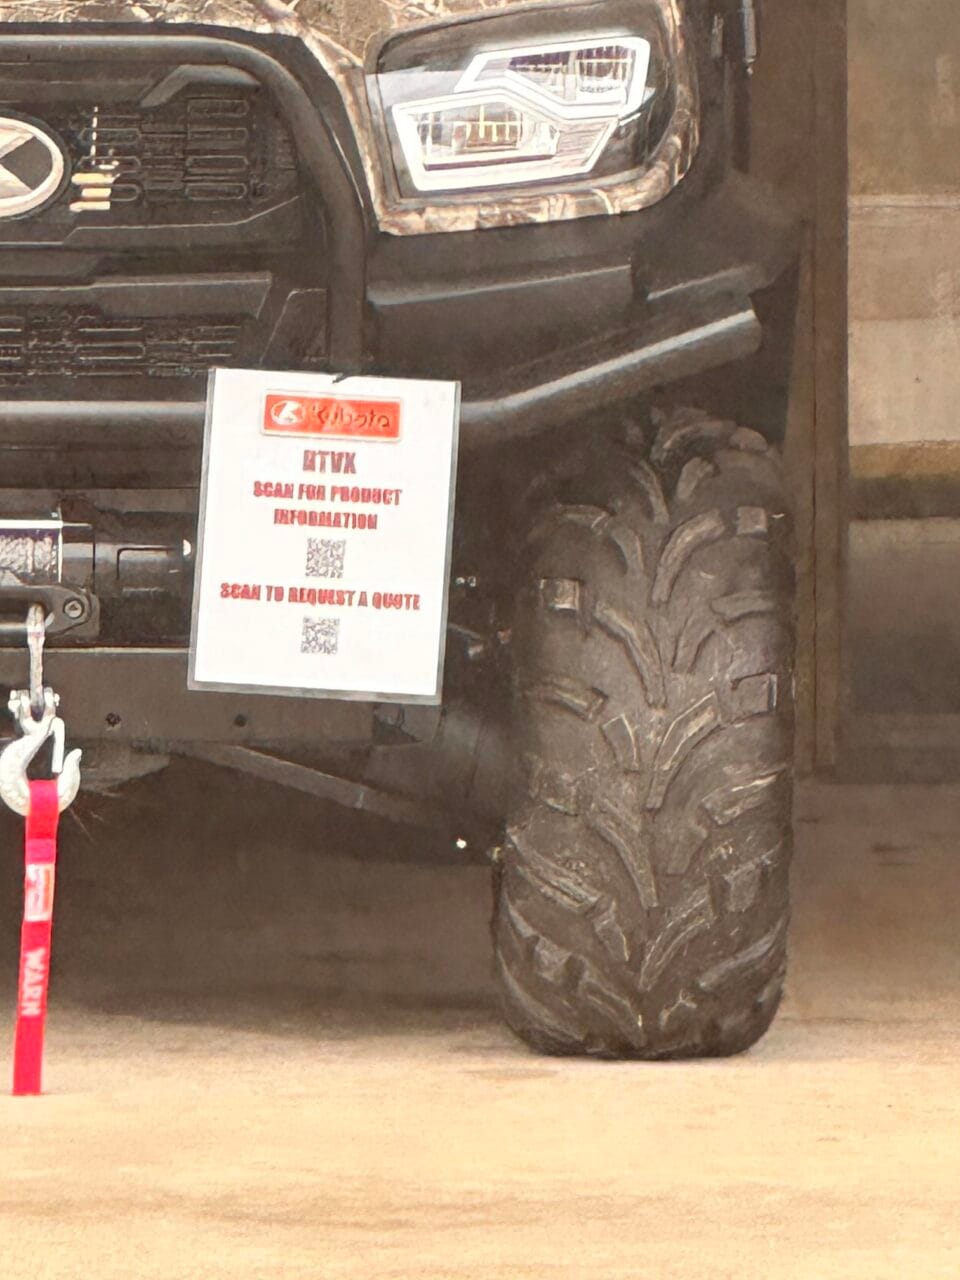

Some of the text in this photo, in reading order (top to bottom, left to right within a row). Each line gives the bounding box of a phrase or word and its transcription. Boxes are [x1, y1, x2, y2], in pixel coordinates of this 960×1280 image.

[303, 449, 356, 474] RTVX
[253, 481, 402, 506] SCAN FOR PRODUCT
[273, 509, 378, 529] INFORMATION
[220, 582, 420, 611] SCAN TO REQUEST A QUOTE
[21, 947, 46, 1016] WARN
